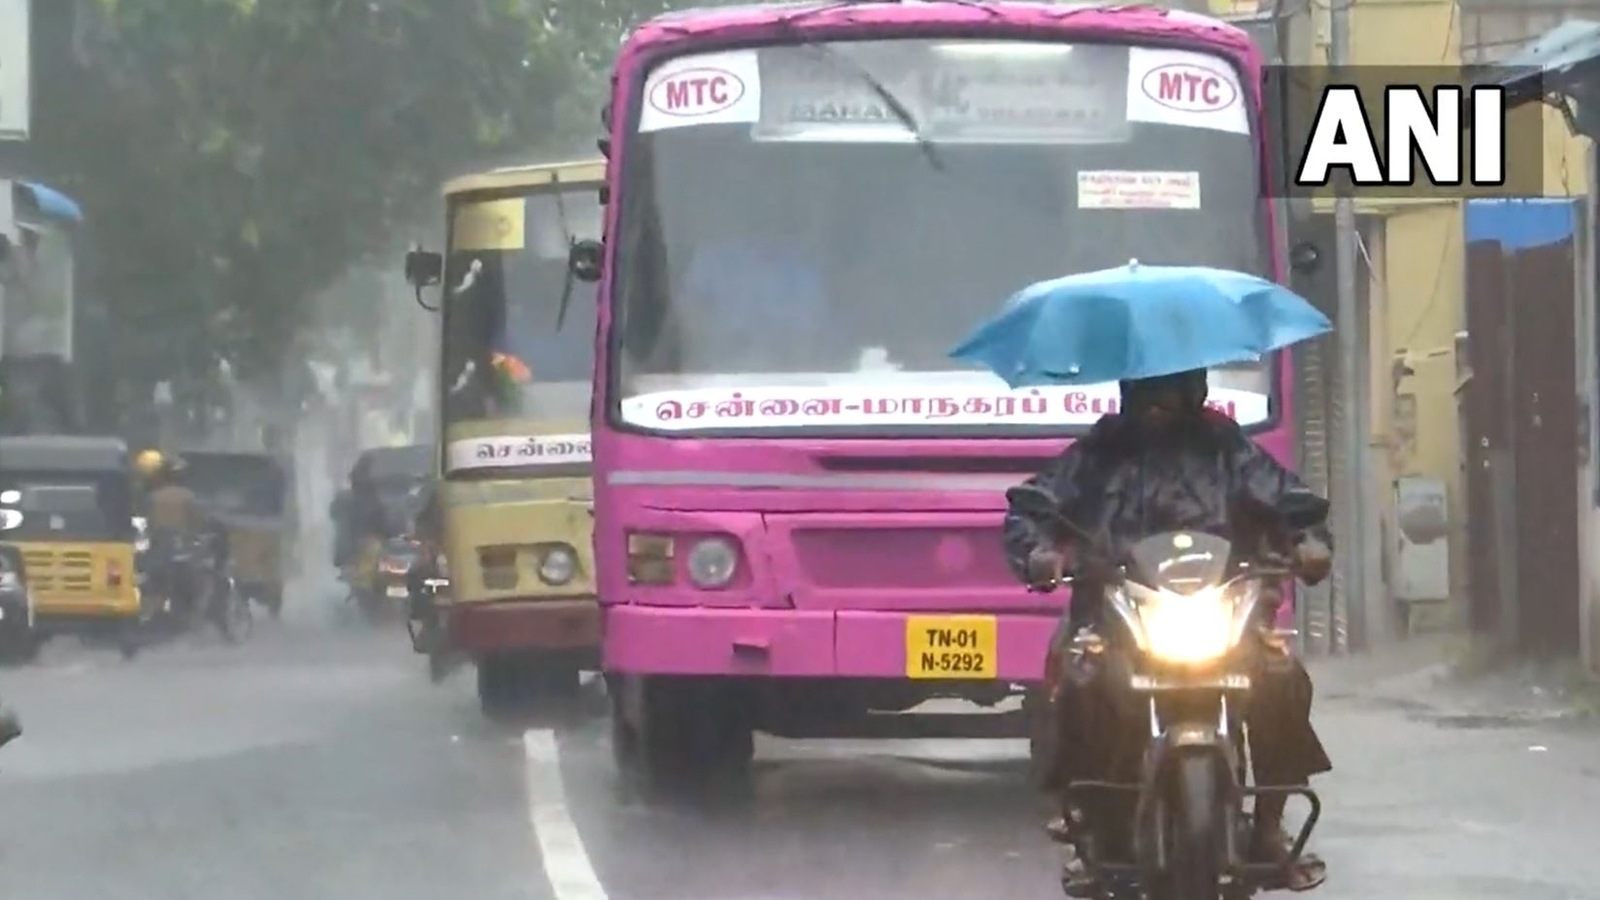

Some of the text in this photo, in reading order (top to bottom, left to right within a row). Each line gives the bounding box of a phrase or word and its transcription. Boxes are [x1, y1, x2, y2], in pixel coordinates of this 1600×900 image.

[666, 76, 728, 109] MTC
[1159, 71, 1221, 105] MTC
[926, 629, 977, 648] TN-01
[921, 652, 984, 672] N-5292
